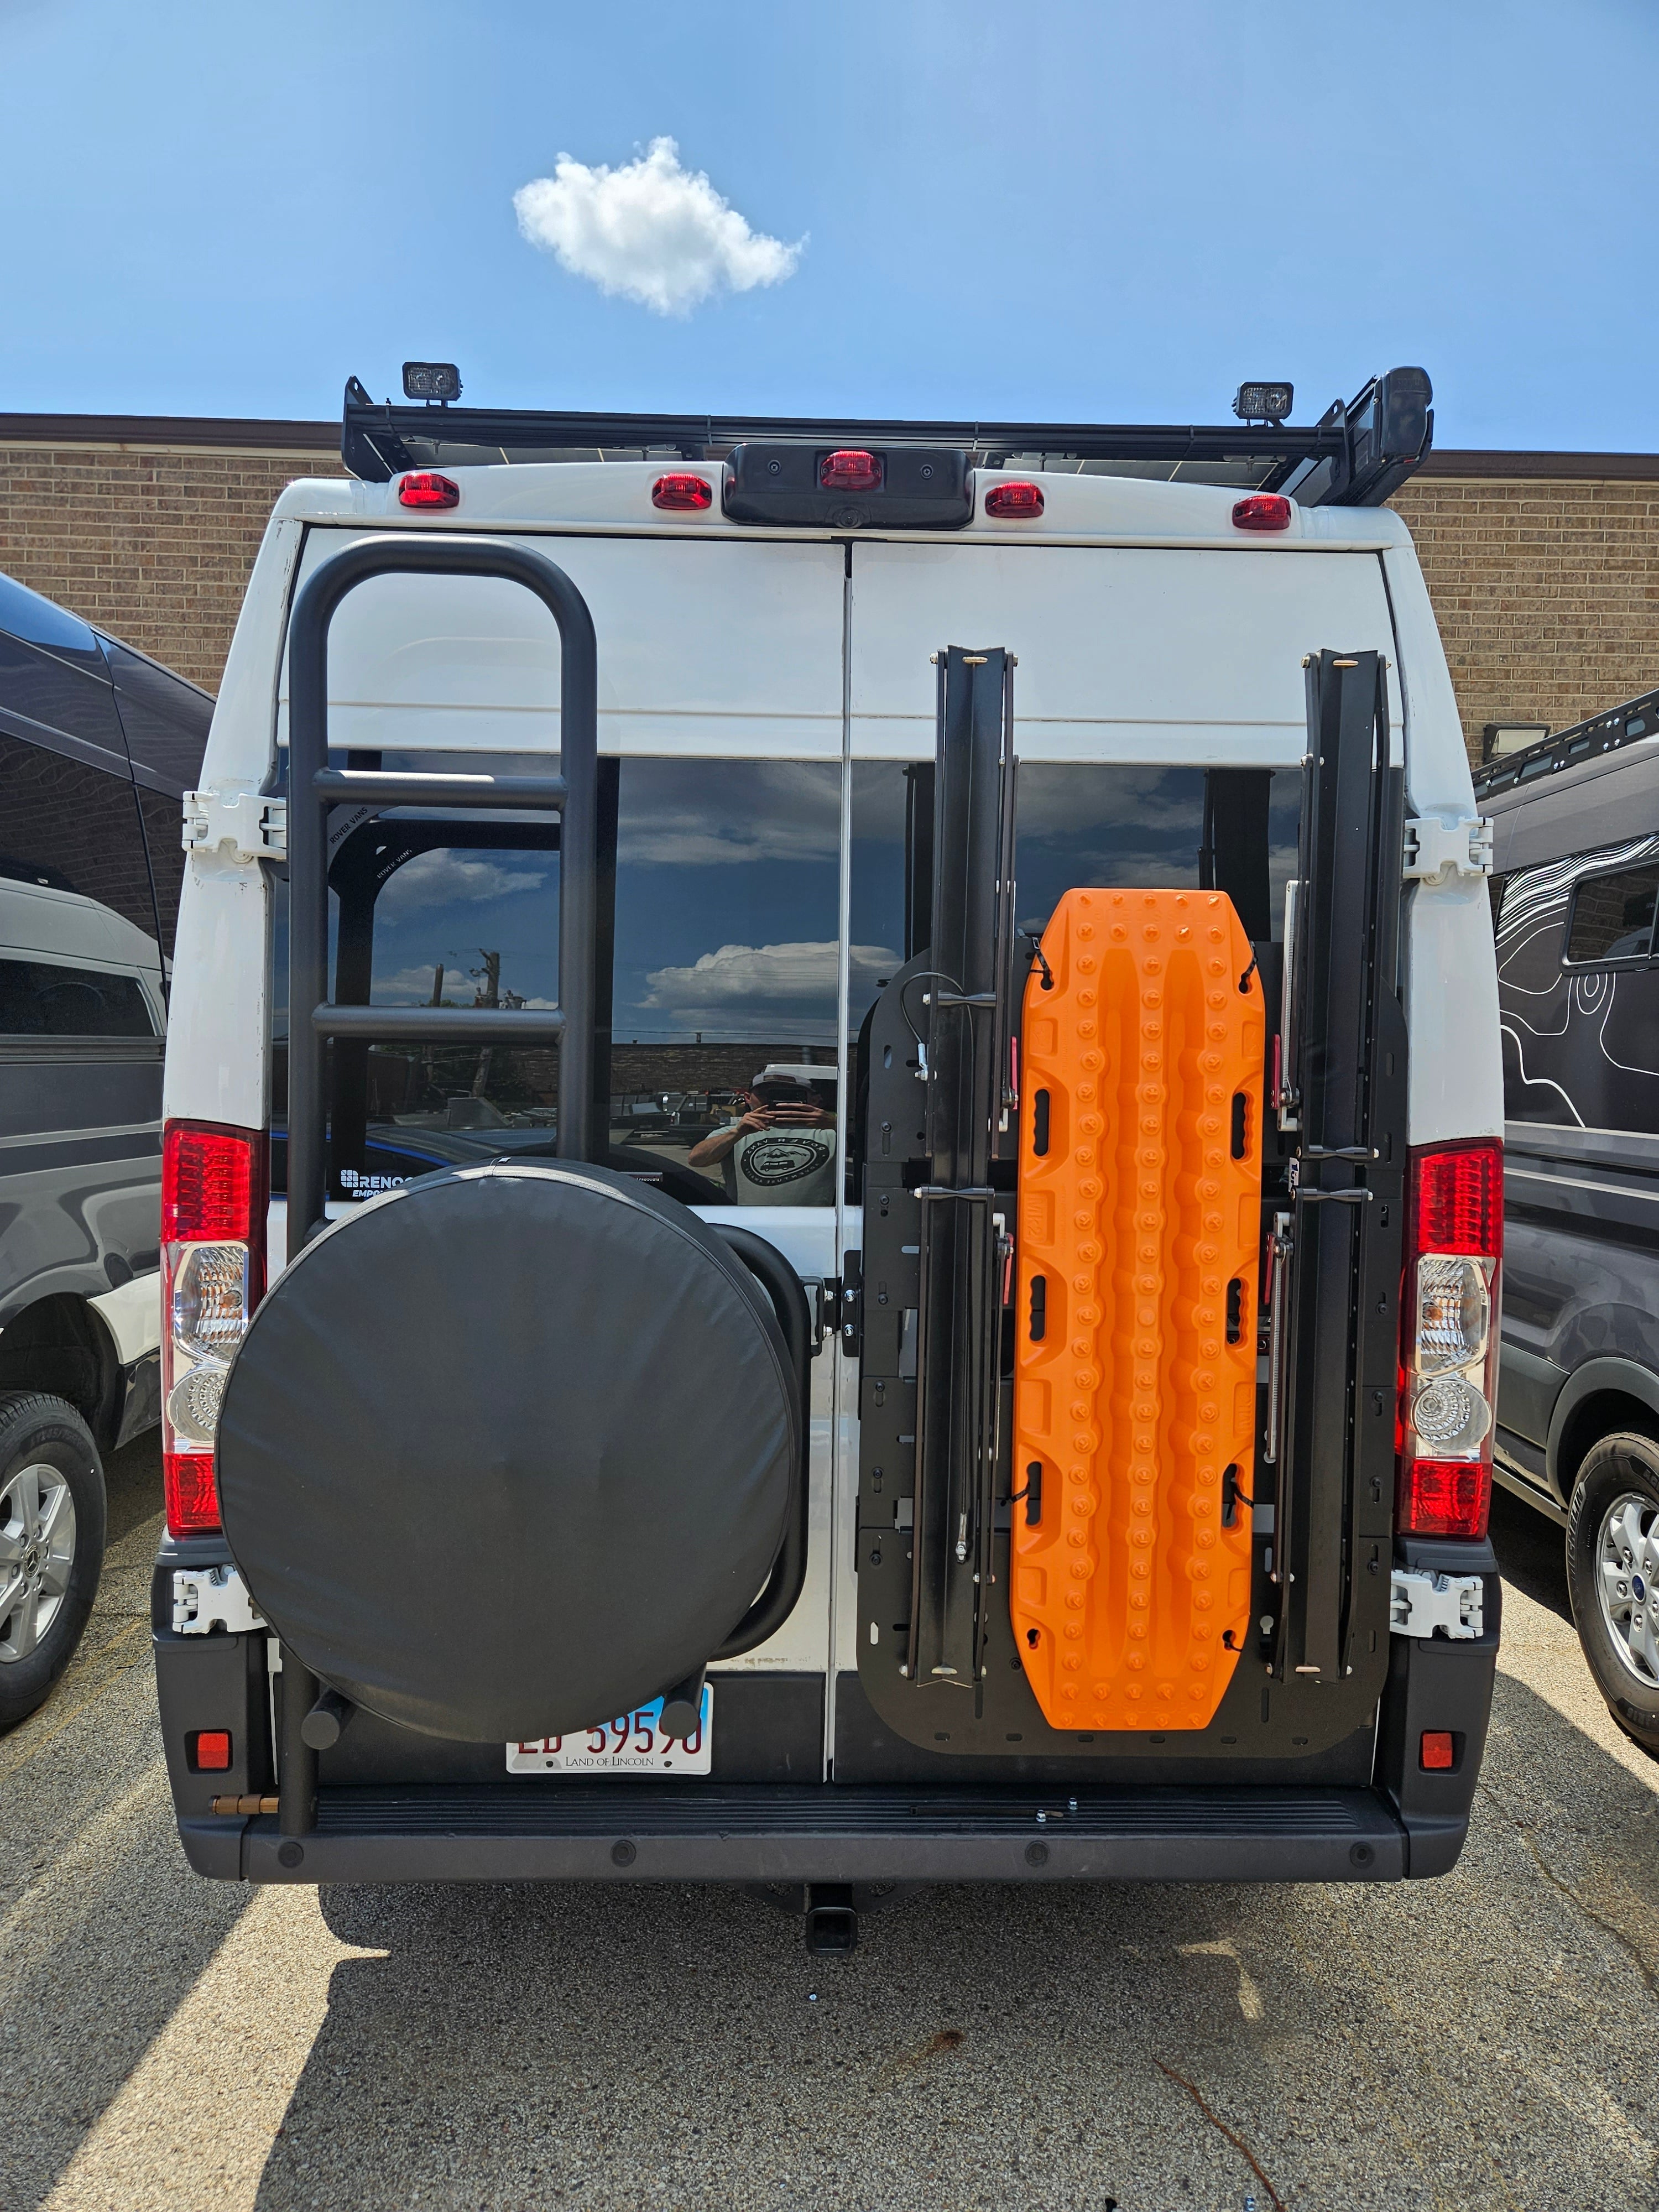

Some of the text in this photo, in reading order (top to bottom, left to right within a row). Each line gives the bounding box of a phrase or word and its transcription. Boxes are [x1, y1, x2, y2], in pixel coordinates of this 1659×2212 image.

[329, 806, 368, 844] ROVER VANS
[377, 862, 396, 879] ROVER
[1568, 1486, 1585, 1580] MICHELIN
[566, 1756, 654, 1766] LAND OF LINCOLN
